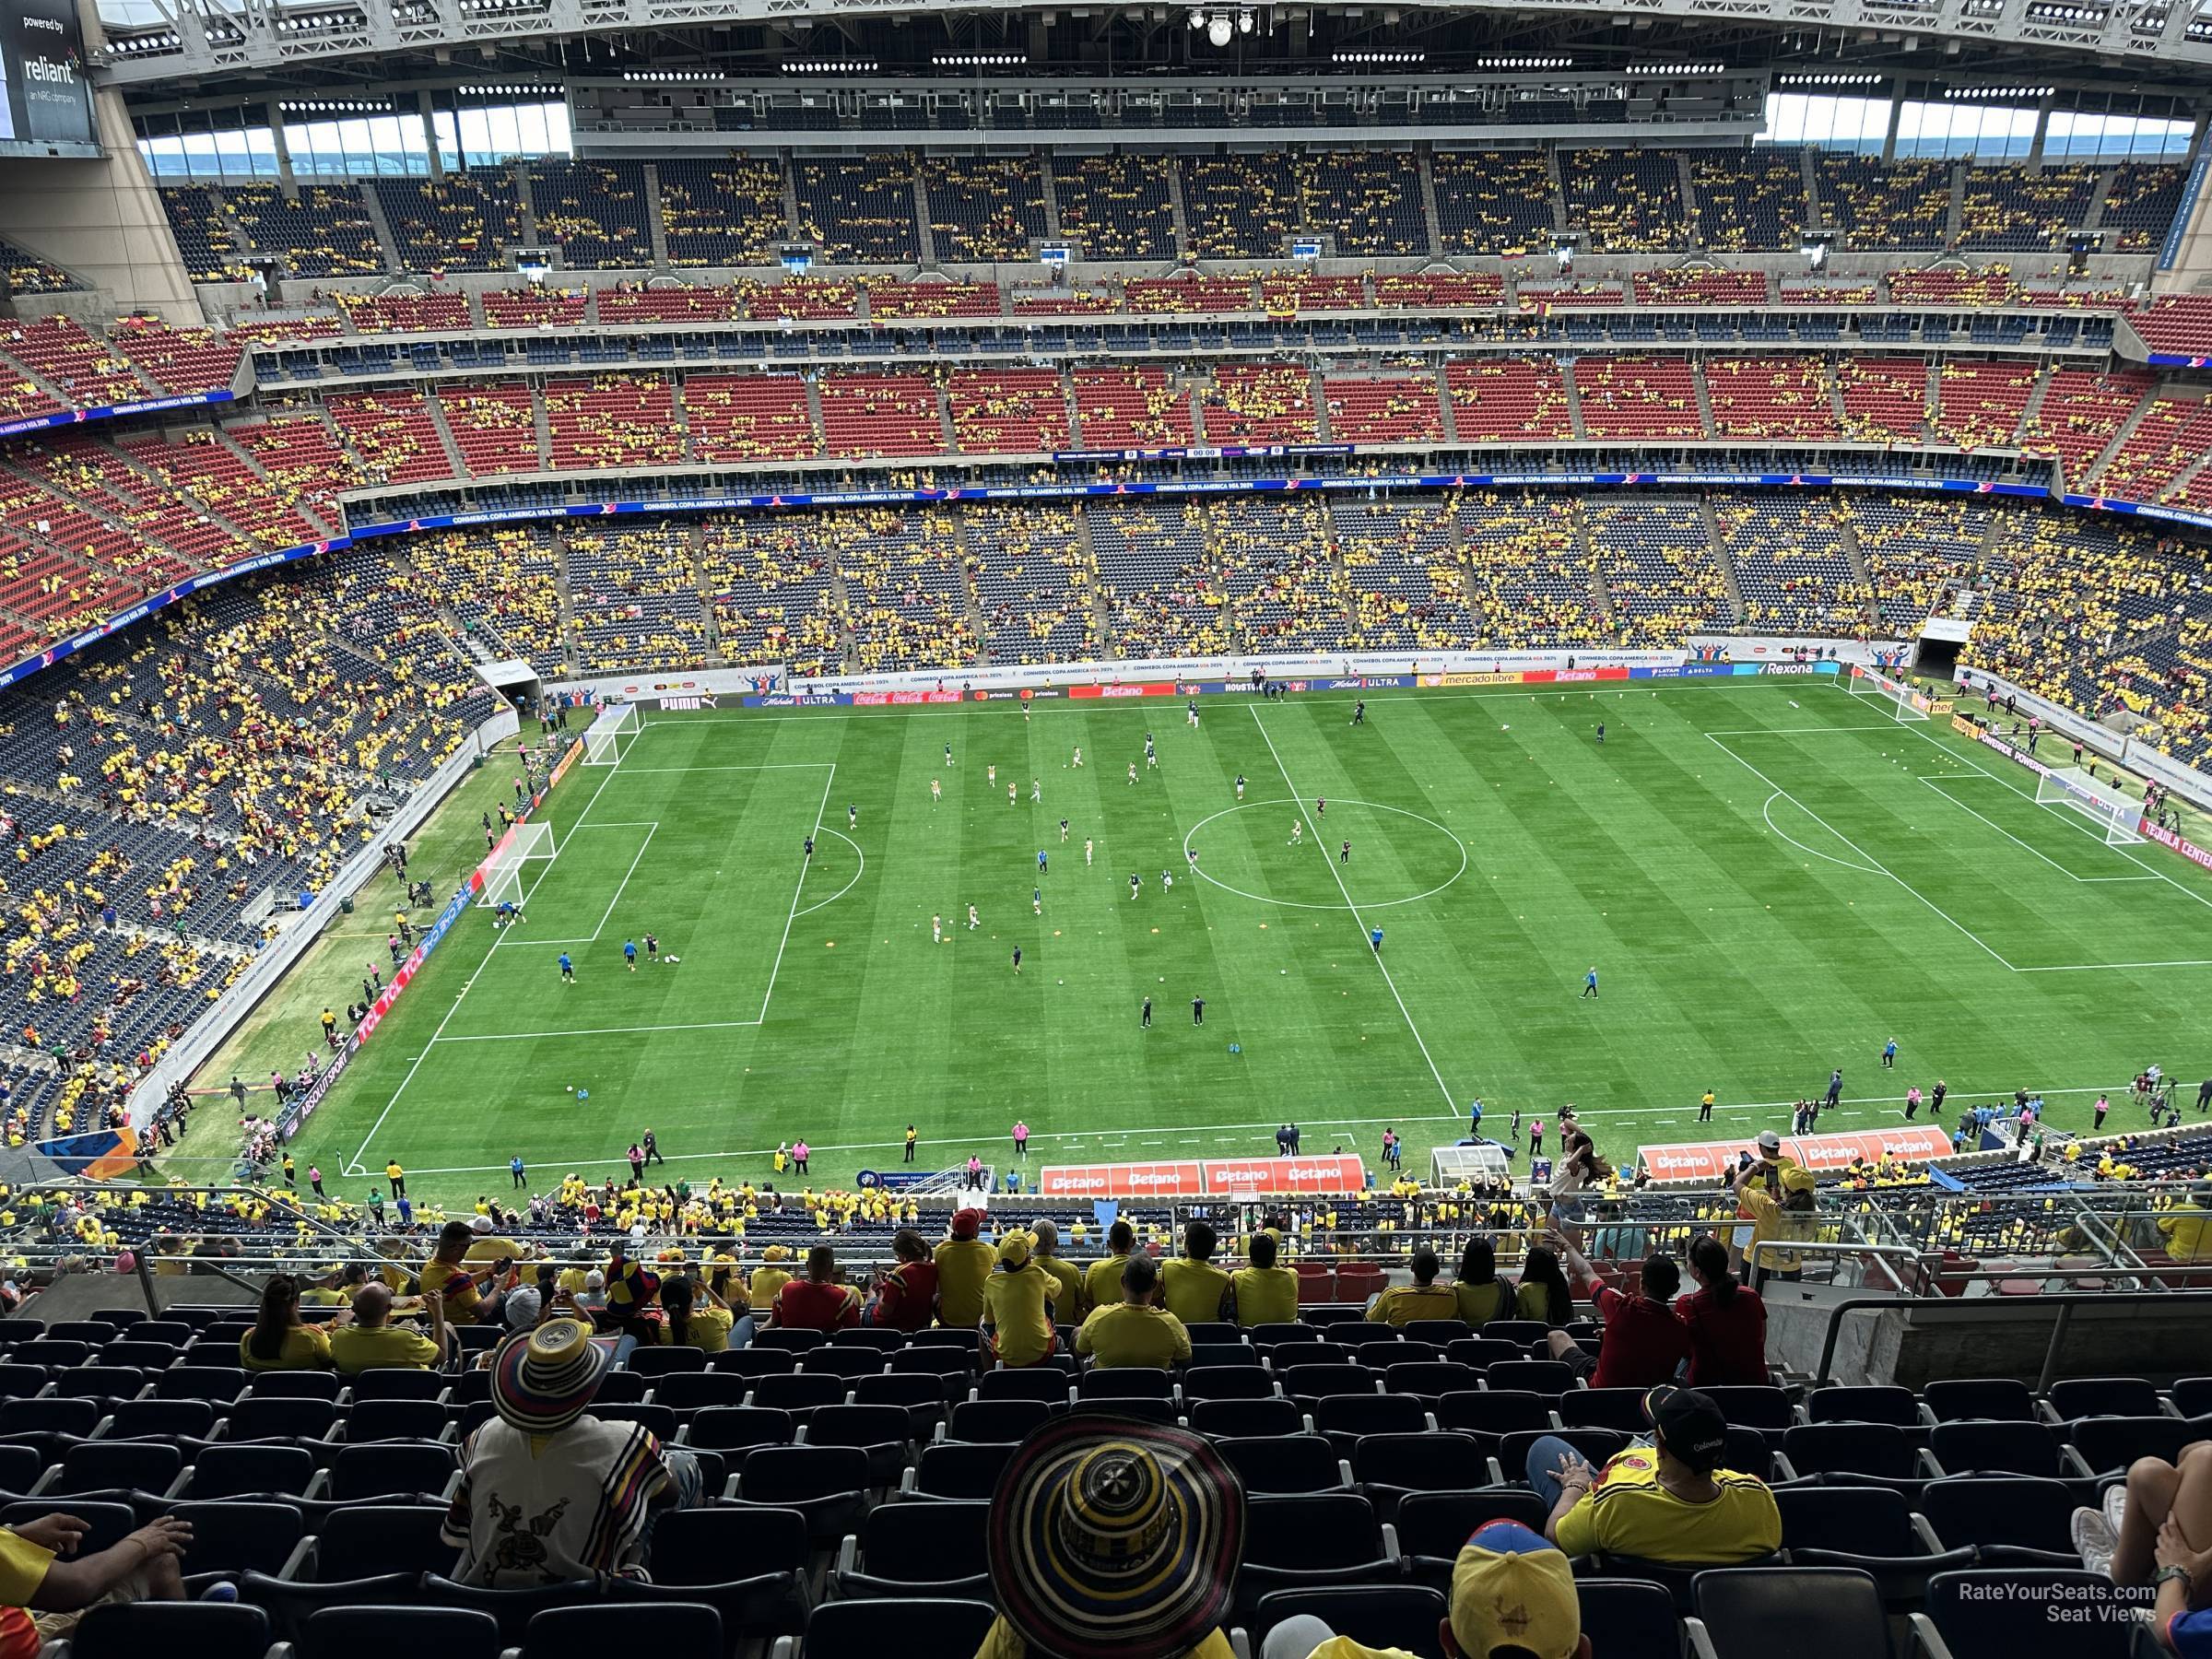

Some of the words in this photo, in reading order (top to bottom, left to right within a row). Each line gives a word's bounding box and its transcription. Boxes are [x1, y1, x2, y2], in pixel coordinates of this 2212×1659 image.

[24, 17, 54, 29] powered
[55, 19, 63, 34] by
[25, 55, 74, 84] reliant
[30, 91, 38, 100] an
[39, 91, 51, 101] NRG
[52, 94, 76, 106] company
[1768, 663, 1813, 674] Rexona
[1445, 675, 1491, 684] mercado
[1493, 674, 1515, 682] libre
[1555, 672, 1596, 681] Betano
[1102, 687, 1143, 697] Betano
[1932, 702, 1953, 712] mer
[1959, 719, 1973, 735] libre
[1978, 732, 2013, 757] POWERADE
[2145, 821, 2179, 850] TEQUILA
[404, 953, 422, 982] TCL
[382, 979, 403, 1009] TCL
[359, 1009, 380, 1041] TCL
[302, 1076, 328, 1119] ABSOLUT
[328, 1051, 347, 1083] SPORT
[1809, 1145, 1859, 1160] Betano
[1884, 1140, 1934, 1154] Betano
[1658, 1155, 1709, 1168] Betano
[1128, 1172, 1181, 1186] Betano
[1215, 1168, 1268, 1183] Betano
[1288, 1166, 1341, 1181] Betano
[1052, 1176, 1105, 1190] Betano
